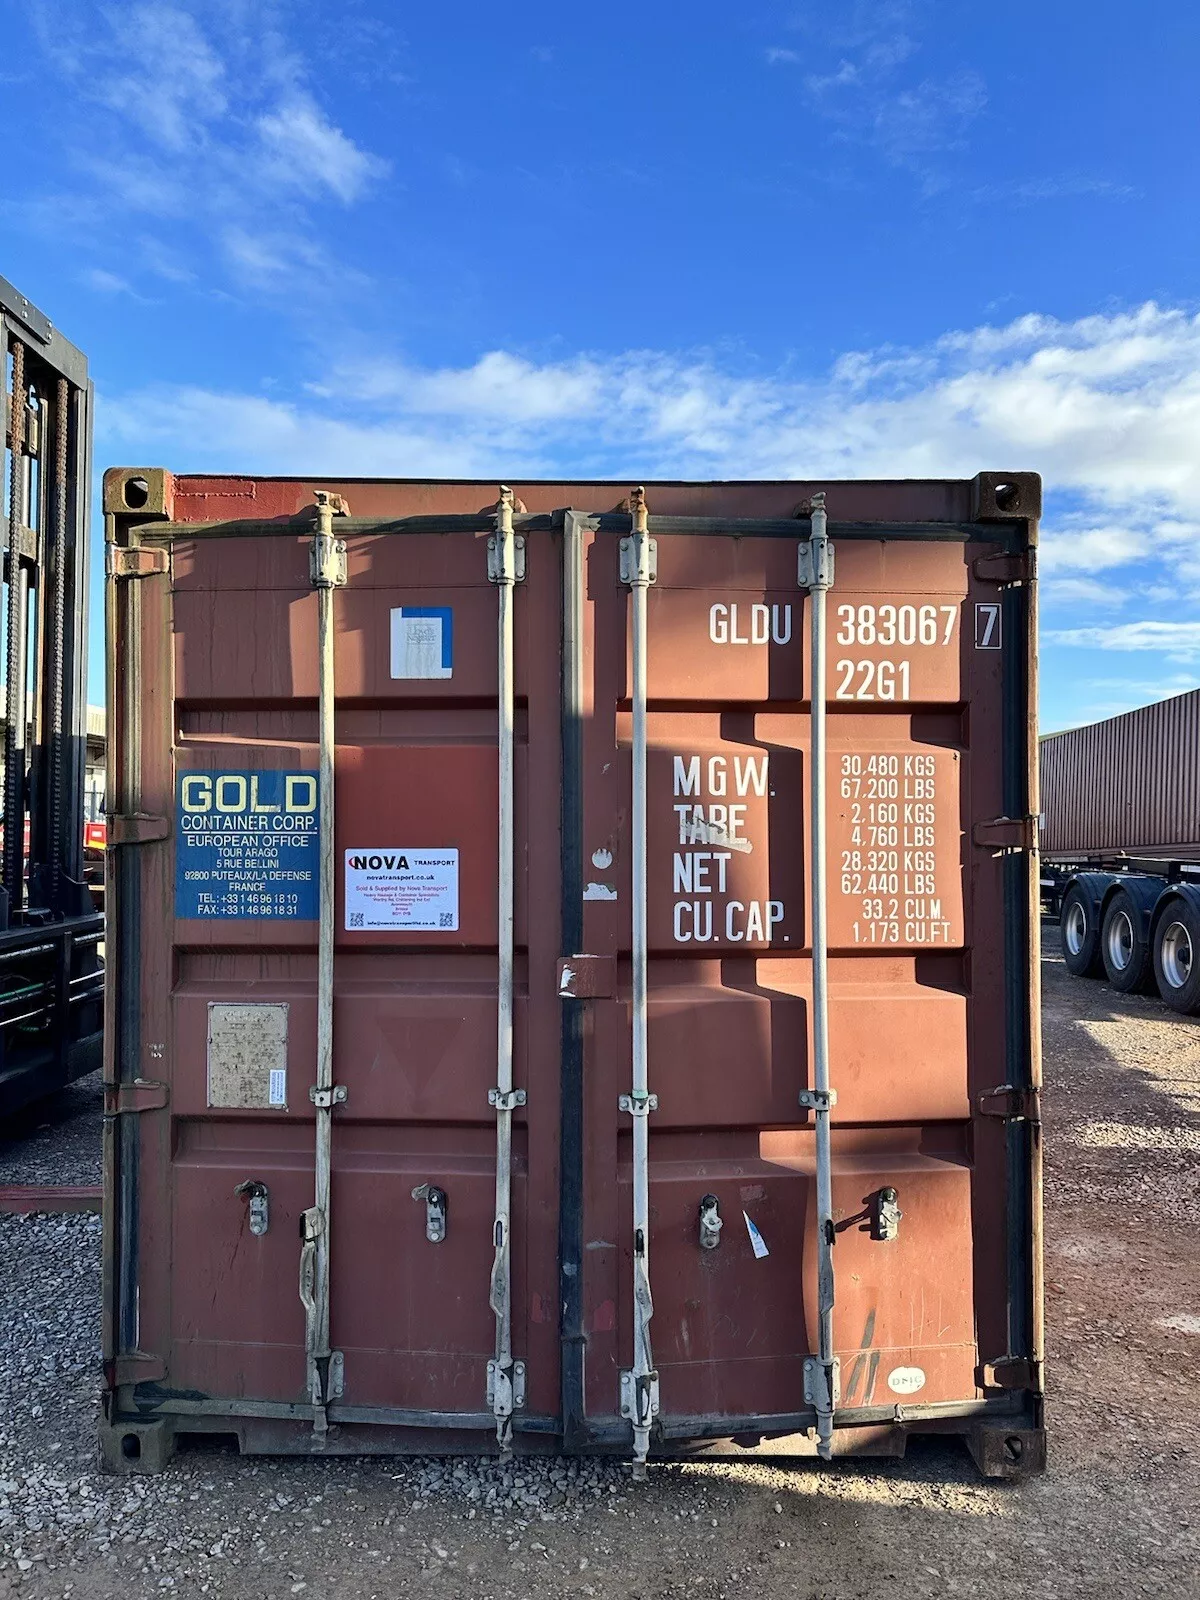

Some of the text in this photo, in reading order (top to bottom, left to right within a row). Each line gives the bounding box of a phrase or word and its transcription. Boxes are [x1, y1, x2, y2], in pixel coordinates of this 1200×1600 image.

[709, 603, 997, 646] GLDU 383067 7
[835, 660, 910, 700] 22G1
[840, 754, 899, 777] 30,480
[903, 754, 936, 777] KGS
[181, 775, 318, 813] GOLD
[840, 777, 936, 800] 67,200 LBS
[181, 815, 318, 831] CONTAINER CORP.
[850, 802, 898, 824] 2,160
[903, 803, 936, 824] KGS
[187, 835, 309, 847] EUROPEAN OFFICE
[850, 825, 936, 847] 4,760 LBS
[216, 859, 279, 869] 5 RUE BELLINI
[218, 848, 278, 858] TOUR ARAGO
[354, 855, 410, 870] NOVA
[184, 871, 209, 880] 92800
[269, 871, 312, 881] DEFENSE
[673, 850, 936, 893] NET 28,320 KGS
[228, 882, 266, 892] FRANCE
[841, 873, 936, 895] 62,440 LBS
[221, 893, 238, 903] +33
[241, 893, 245, 903] 1
[247, 893, 259, 903] 46
[260, 893, 272, 903] 96
[274, 893, 285, 903] 18
[287, 893, 298, 903] 10
[862, 898, 899, 920] 33.2
[197, 905, 298, 915] FAX: +33 1 46 96 18 31
[852, 921, 900, 943] 1,173
